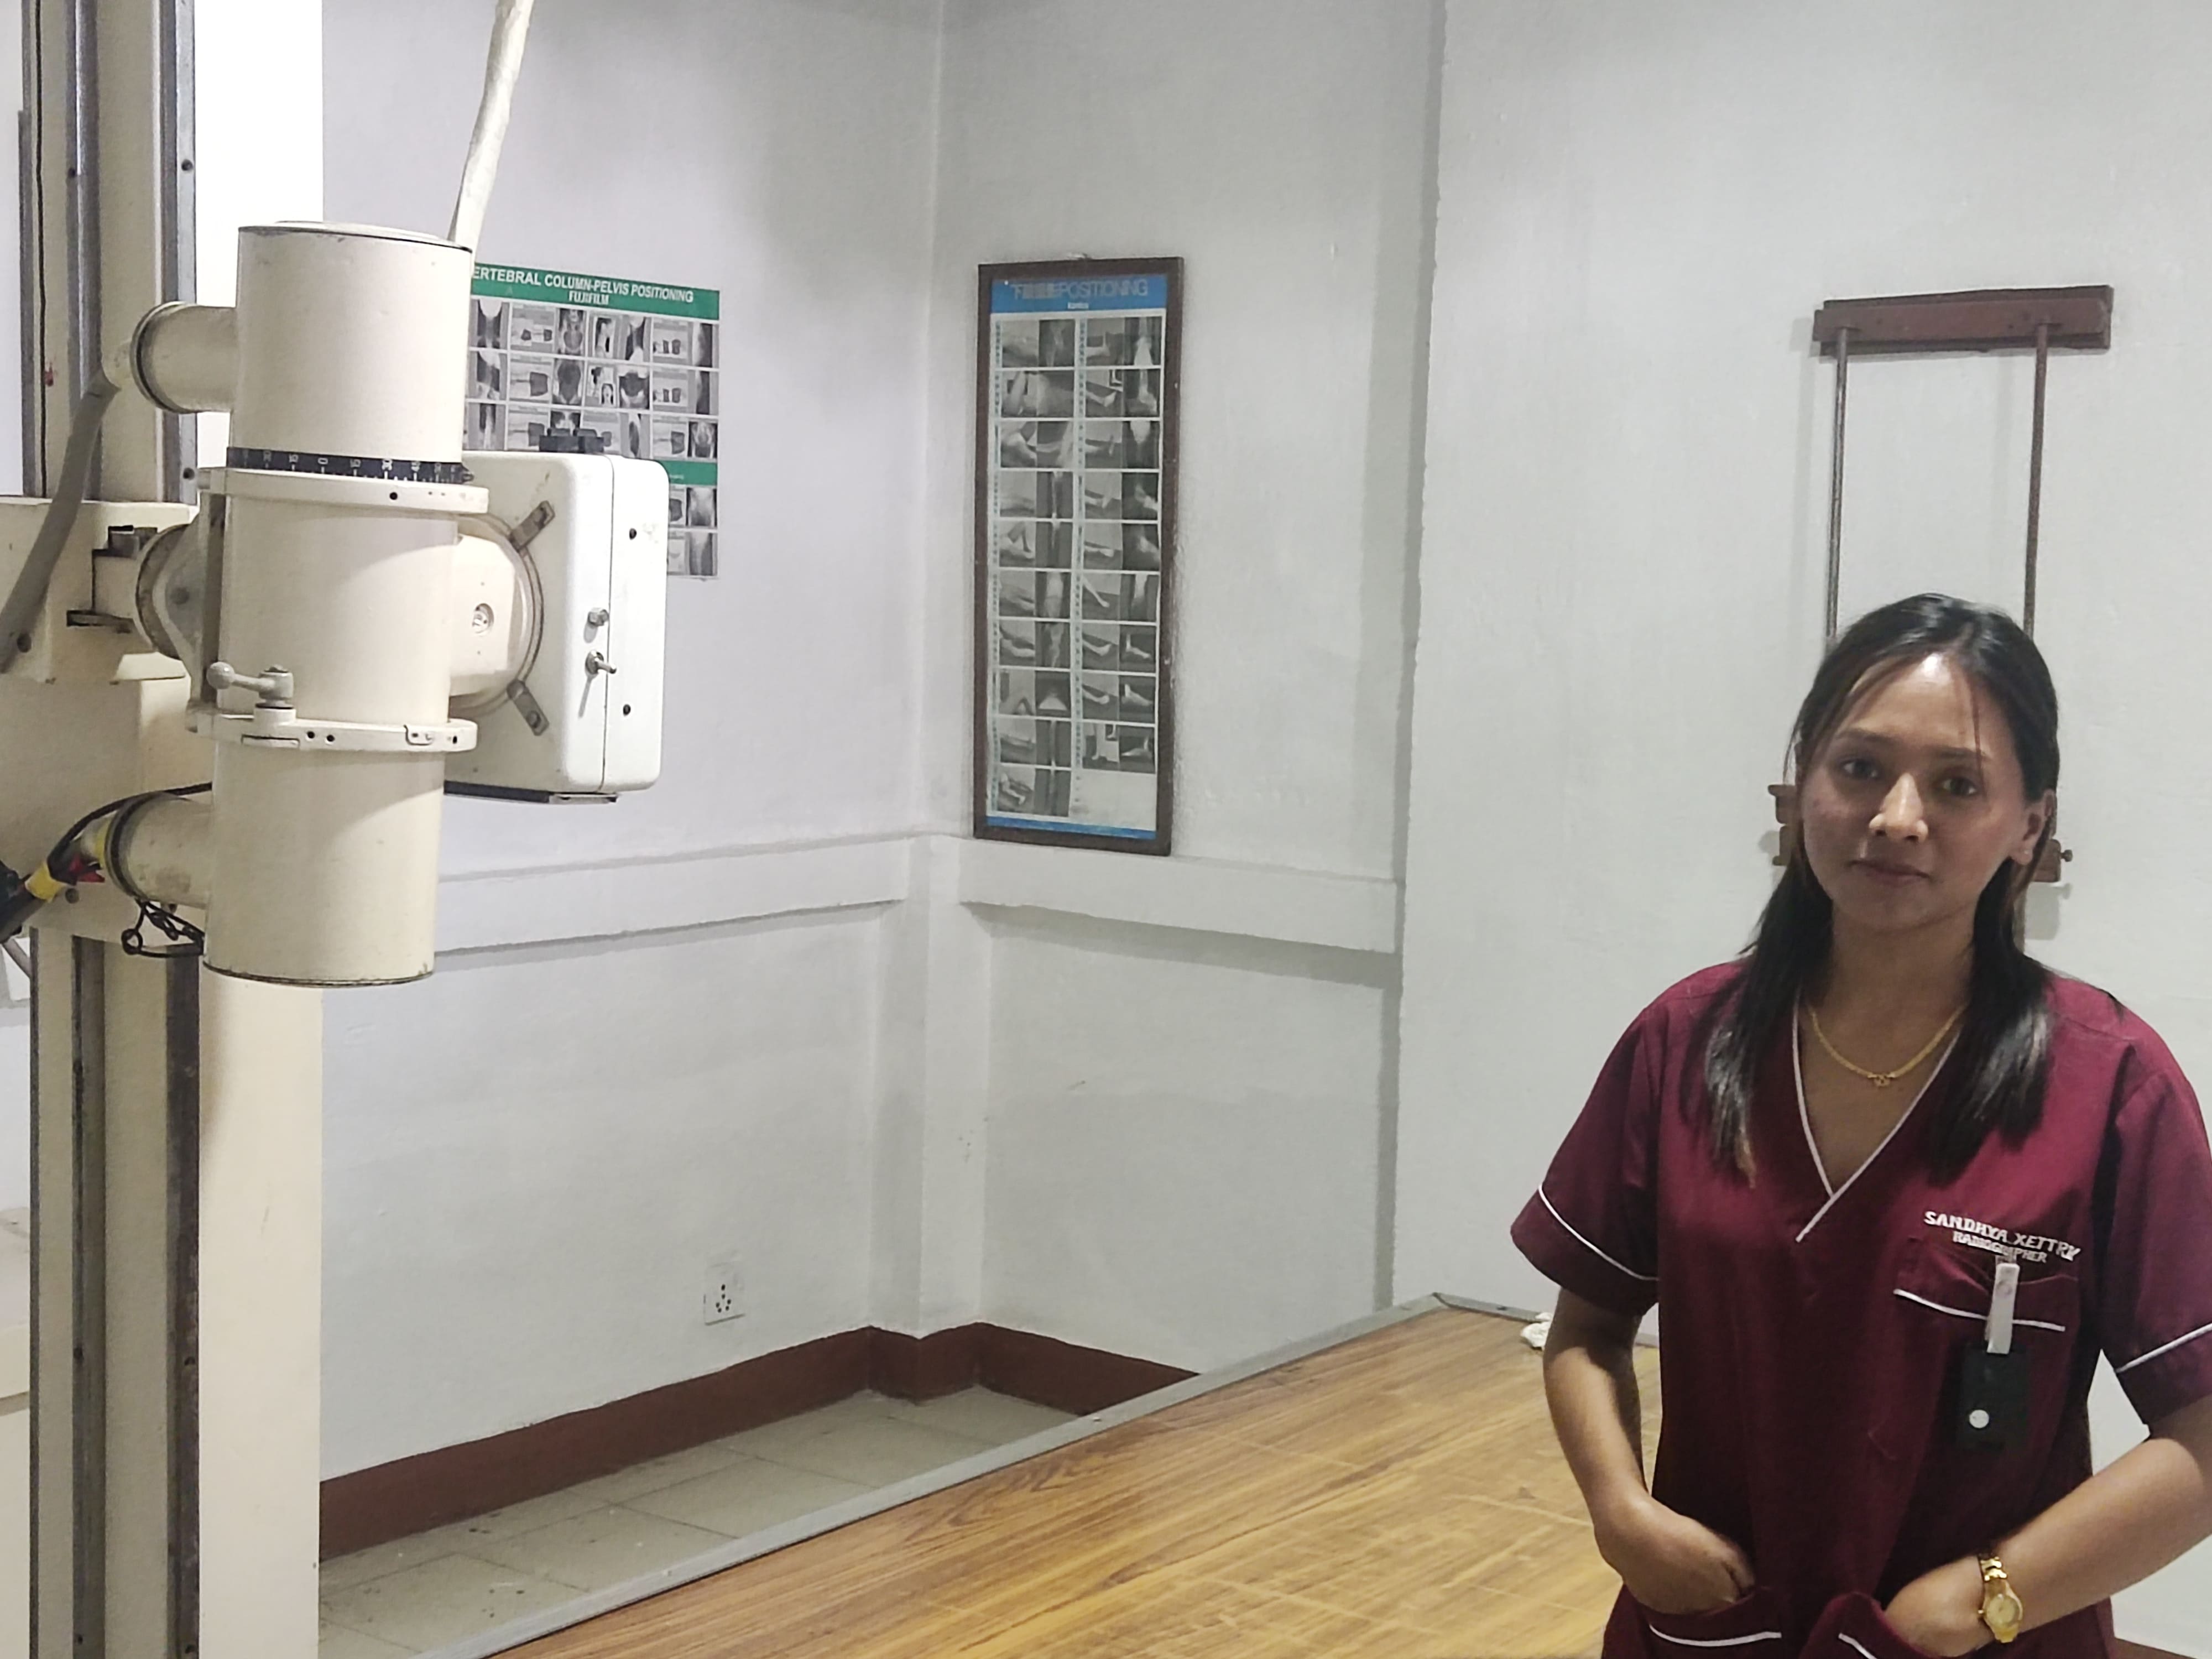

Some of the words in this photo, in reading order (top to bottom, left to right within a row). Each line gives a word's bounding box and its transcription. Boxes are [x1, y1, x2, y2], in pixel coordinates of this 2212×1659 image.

[473, 266, 542, 286] ERTEBRAL
[544, 274, 629, 296] COLUMN-PELVIS
[630, 283, 694, 303] POSITIONING
[568, 290, 609, 305] FUJIFILM
[317, 457, 328, 466] 0
[1923, 1211, 2008, 1243] SANDHYA
